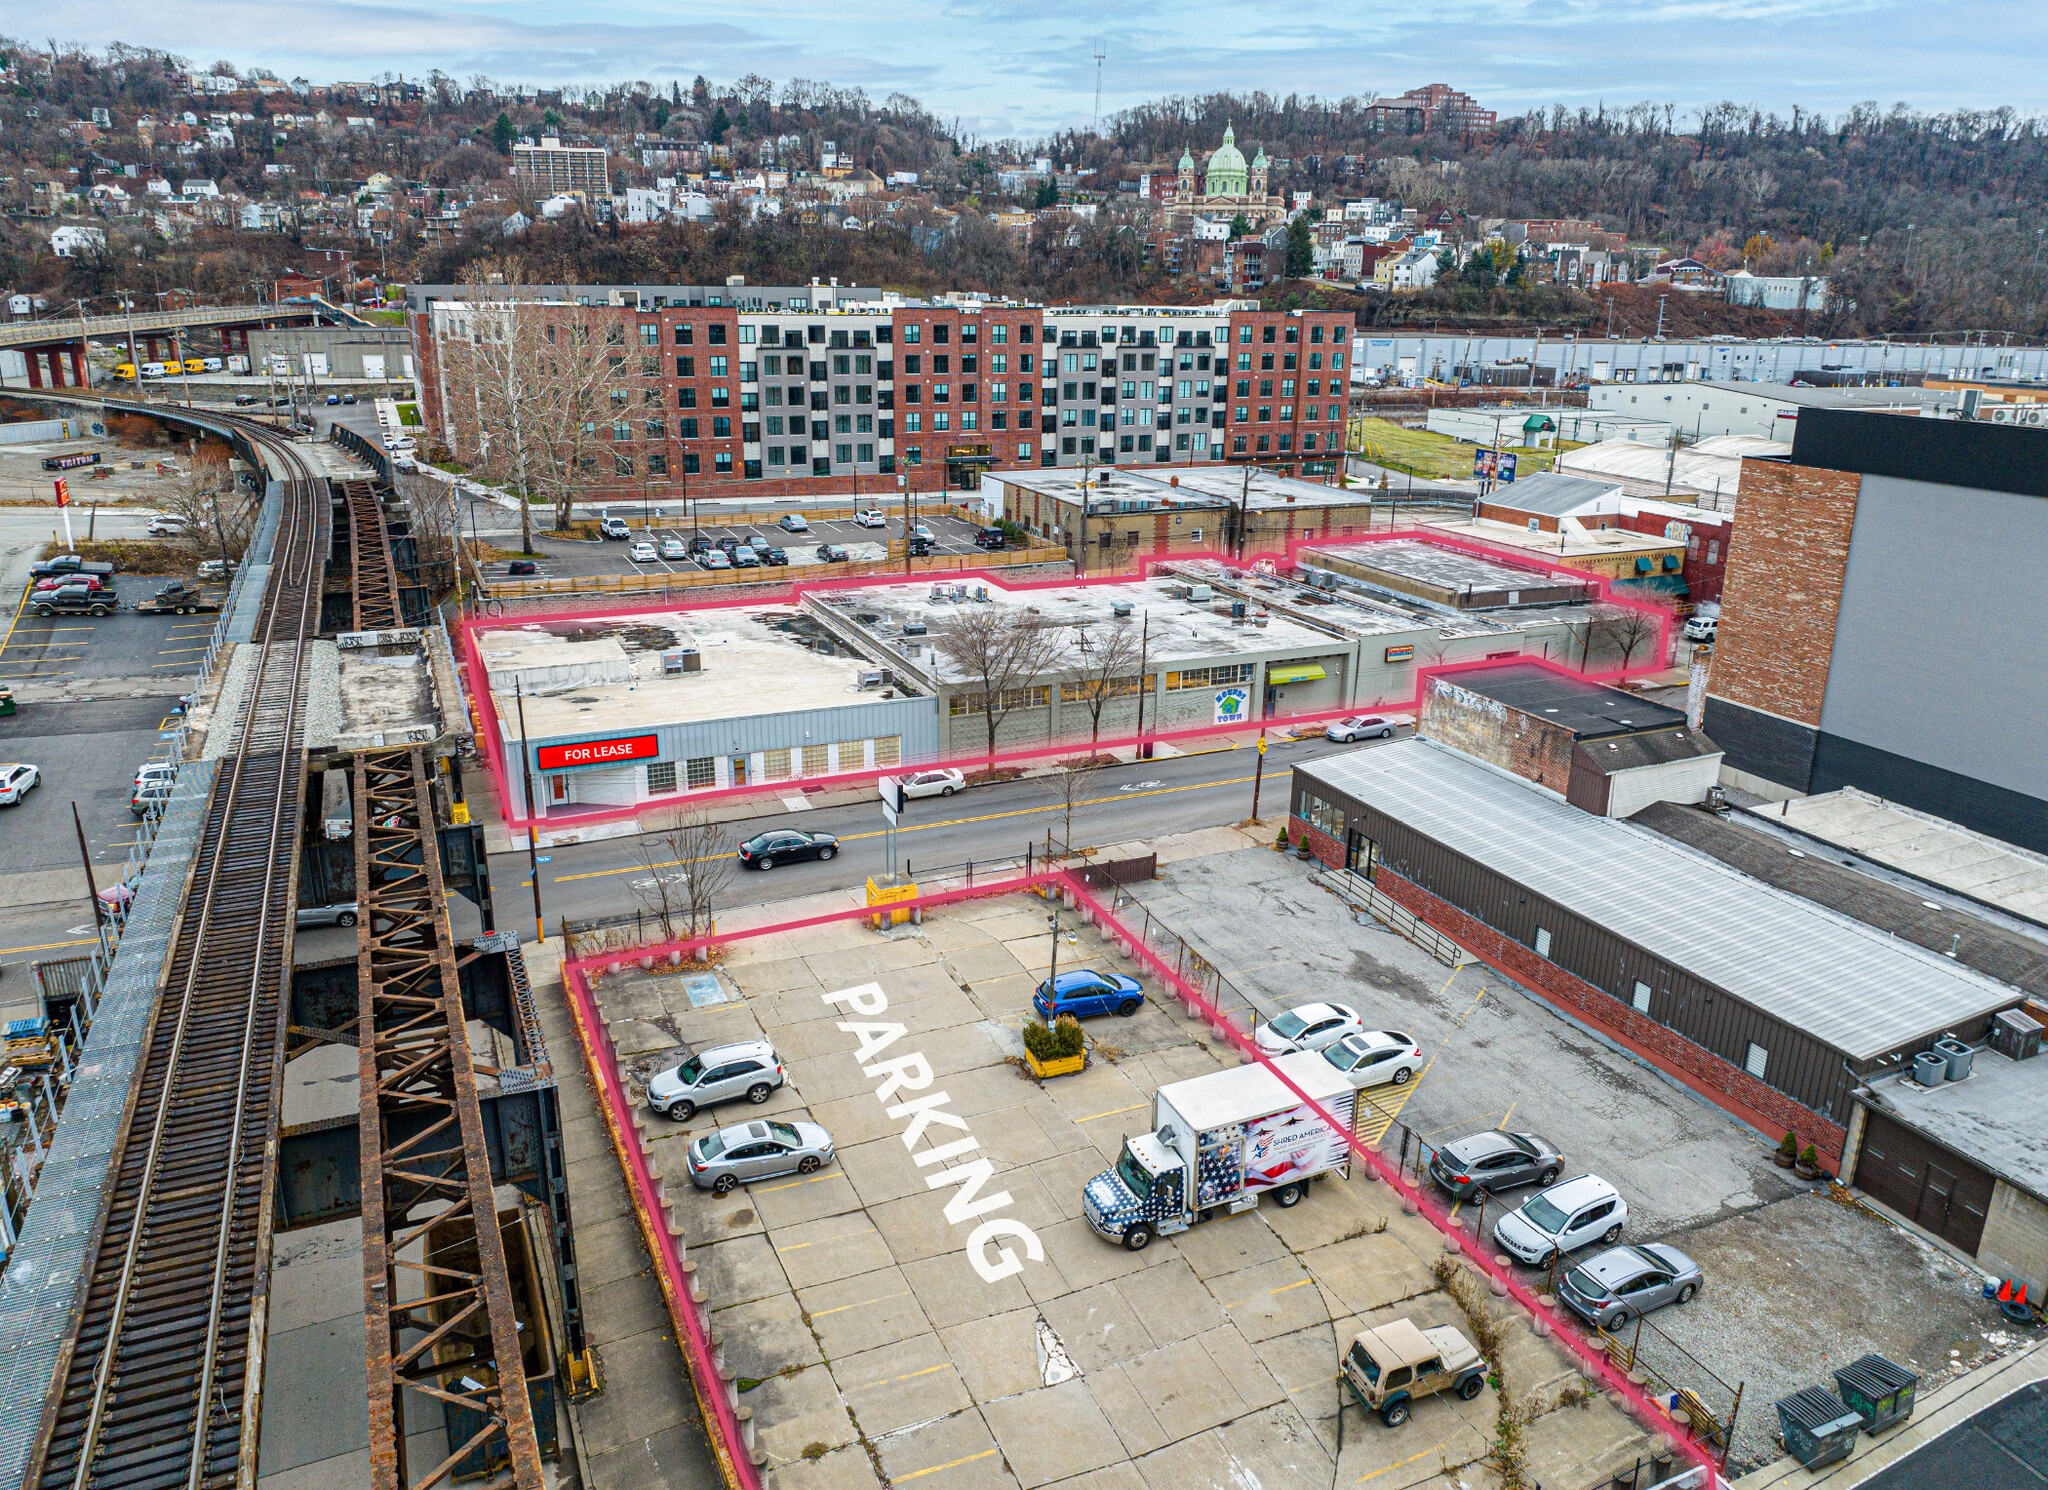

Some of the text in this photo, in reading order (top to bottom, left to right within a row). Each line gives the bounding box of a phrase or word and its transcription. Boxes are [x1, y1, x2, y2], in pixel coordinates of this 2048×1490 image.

[1217, 713, 1242, 722] TOWN
[1273, 1125, 1332, 1146] SHRED AMERICA
